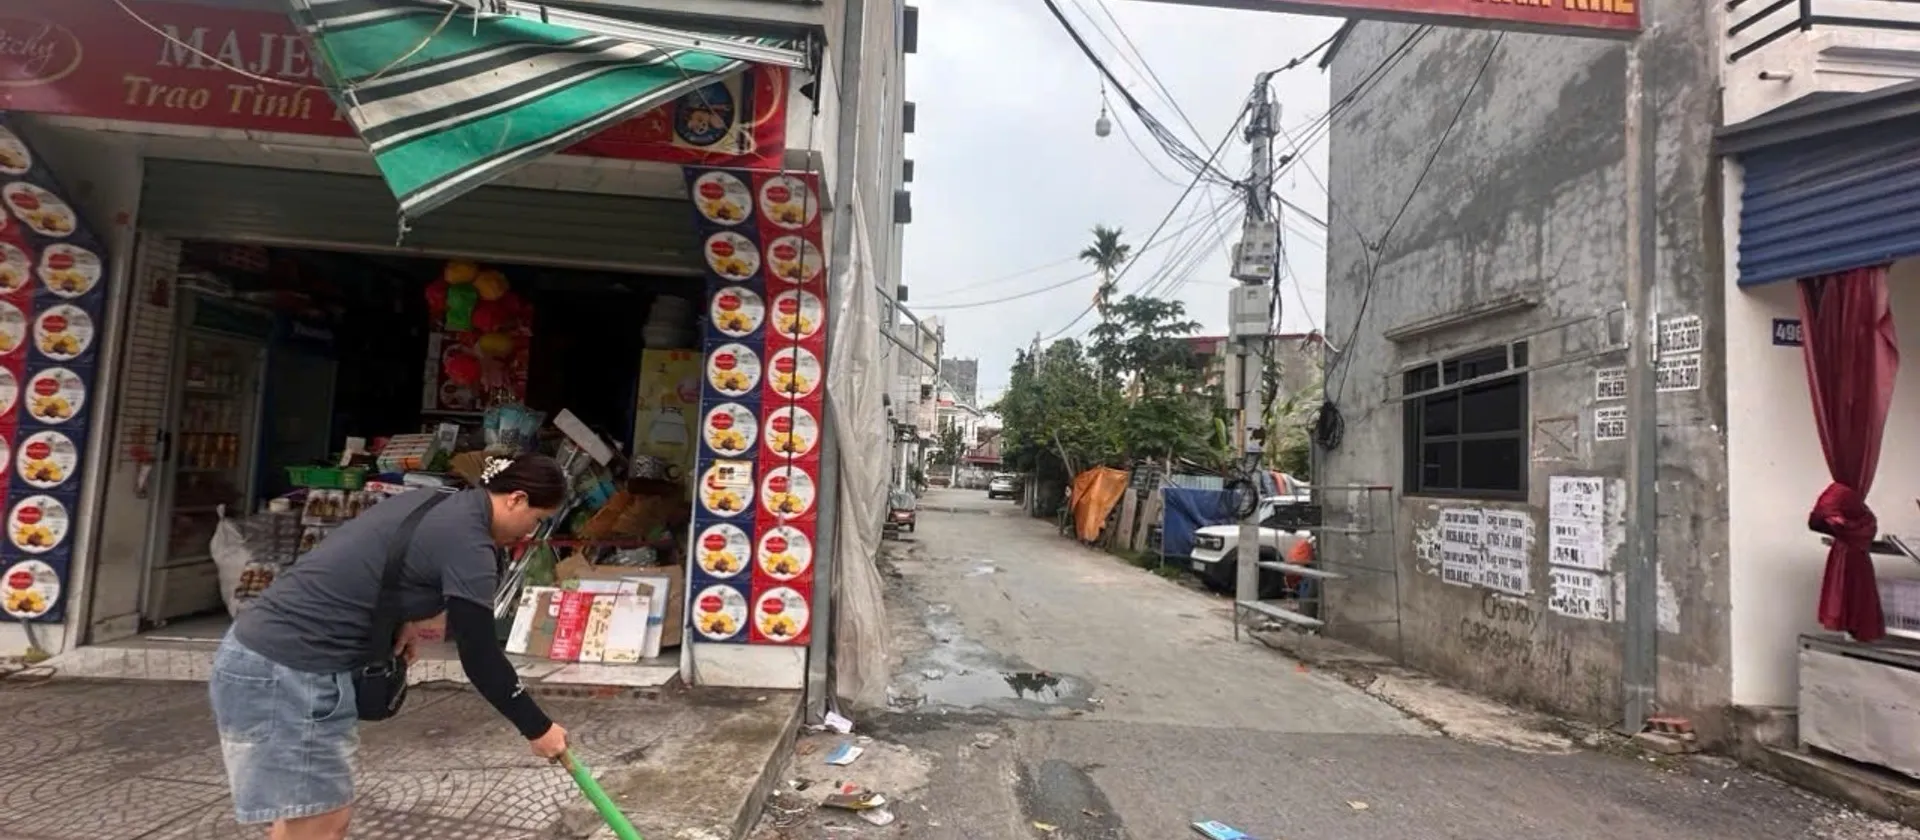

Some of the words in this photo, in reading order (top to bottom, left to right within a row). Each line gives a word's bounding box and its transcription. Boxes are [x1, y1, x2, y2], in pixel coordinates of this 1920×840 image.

[0, 25, 58, 75] ichy
[156, 24, 323, 79] MAJE
[123, 75, 211, 110] Trao
[227, 83, 312, 119] Tình
